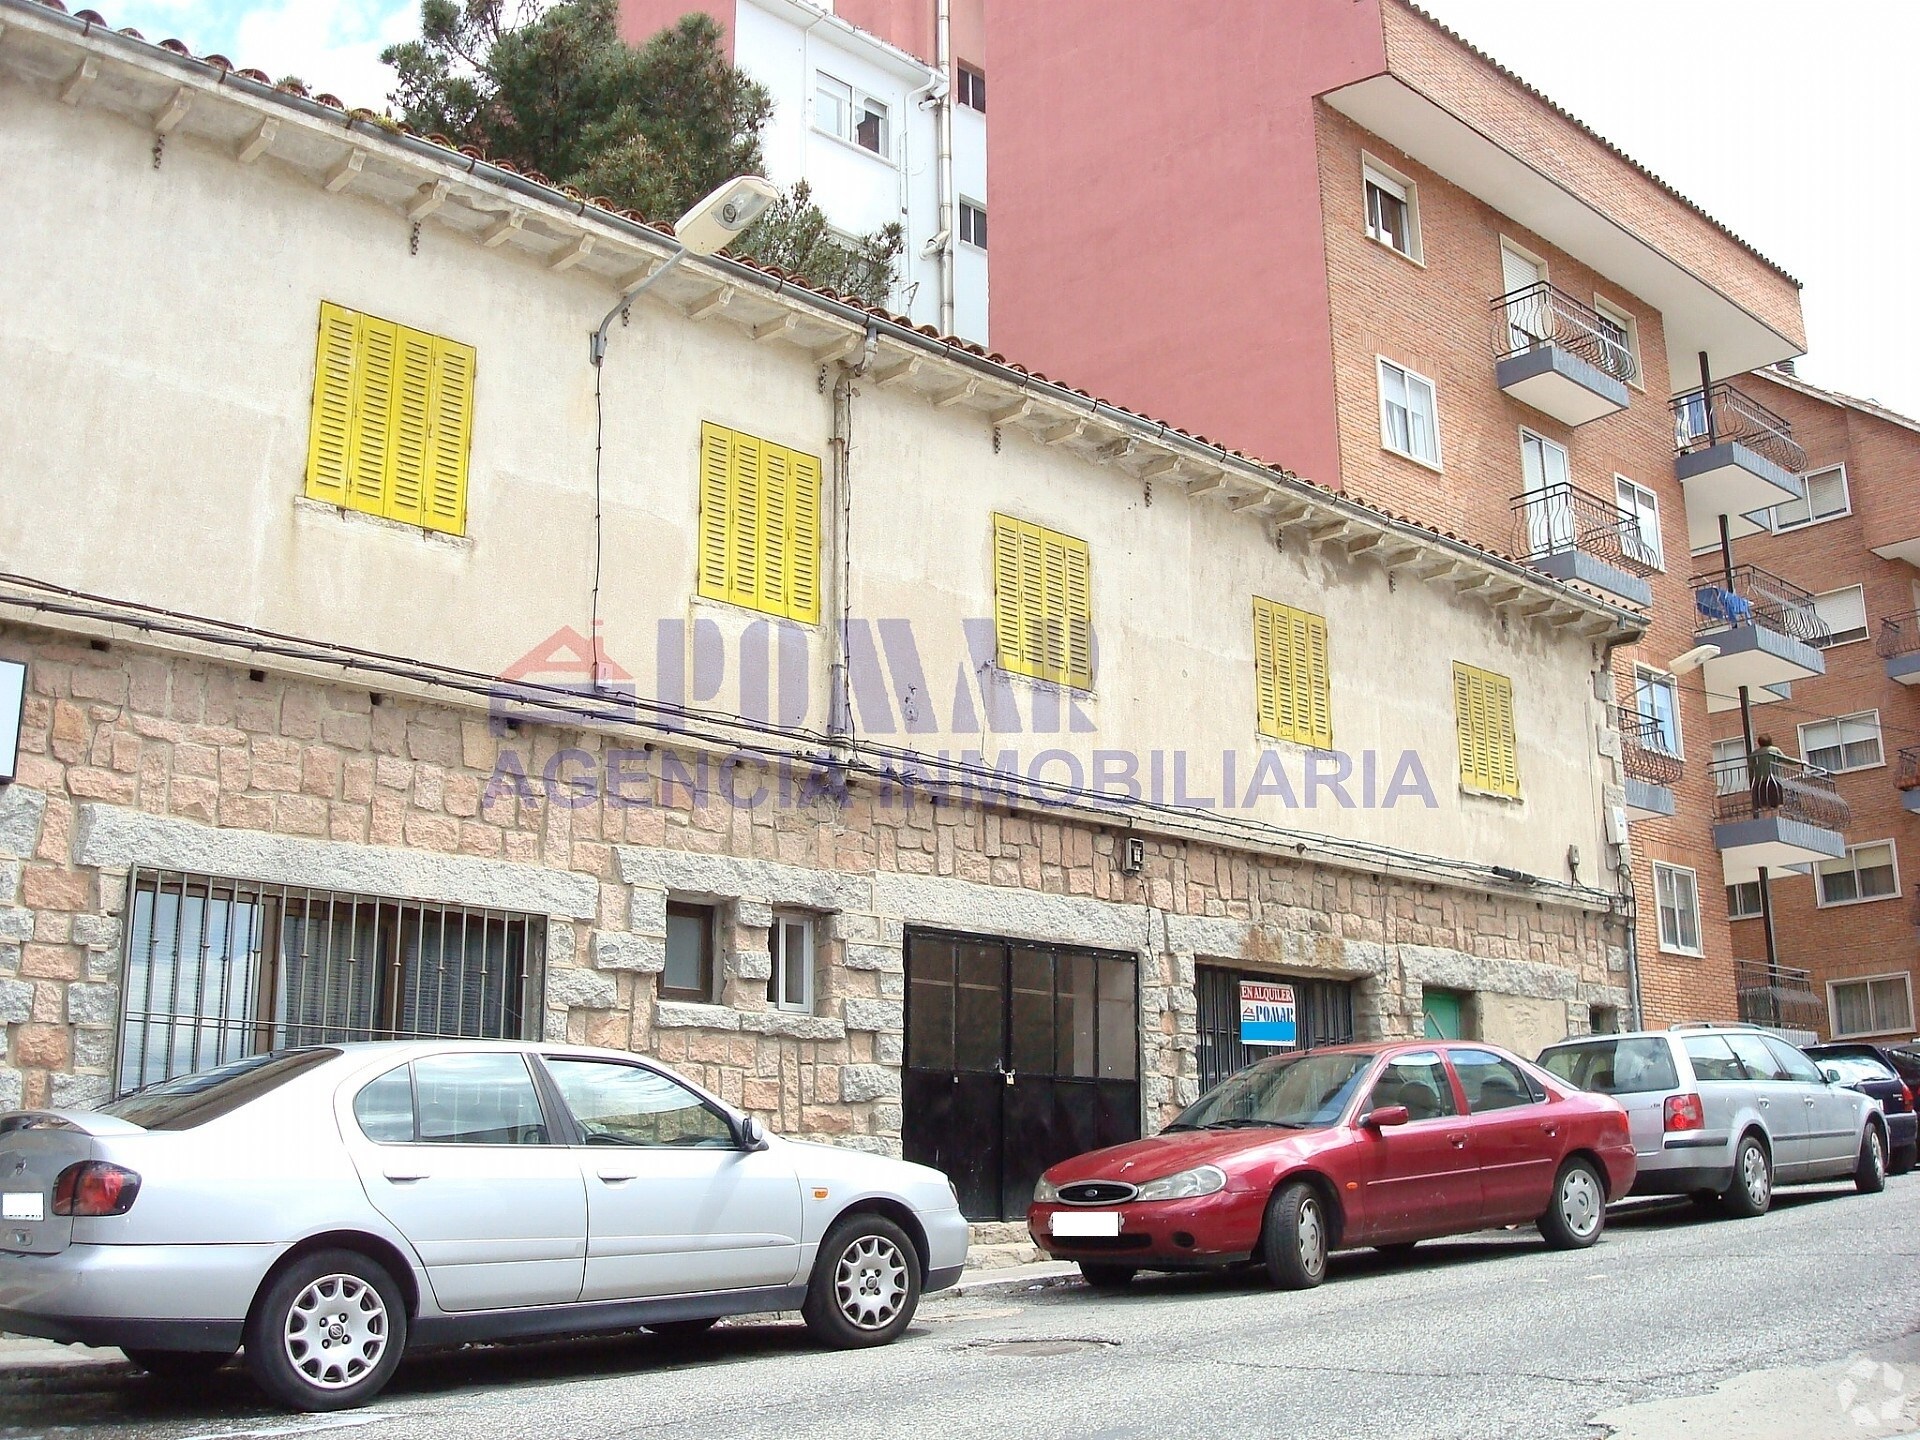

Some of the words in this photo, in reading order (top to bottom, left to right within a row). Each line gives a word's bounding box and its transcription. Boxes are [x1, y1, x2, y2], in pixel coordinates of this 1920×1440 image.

[1241, 986, 1253, 999] EN
[1254, 986, 1292, 1002] ALQUILER
[1255, 1004, 1294, 1022] POMAR
